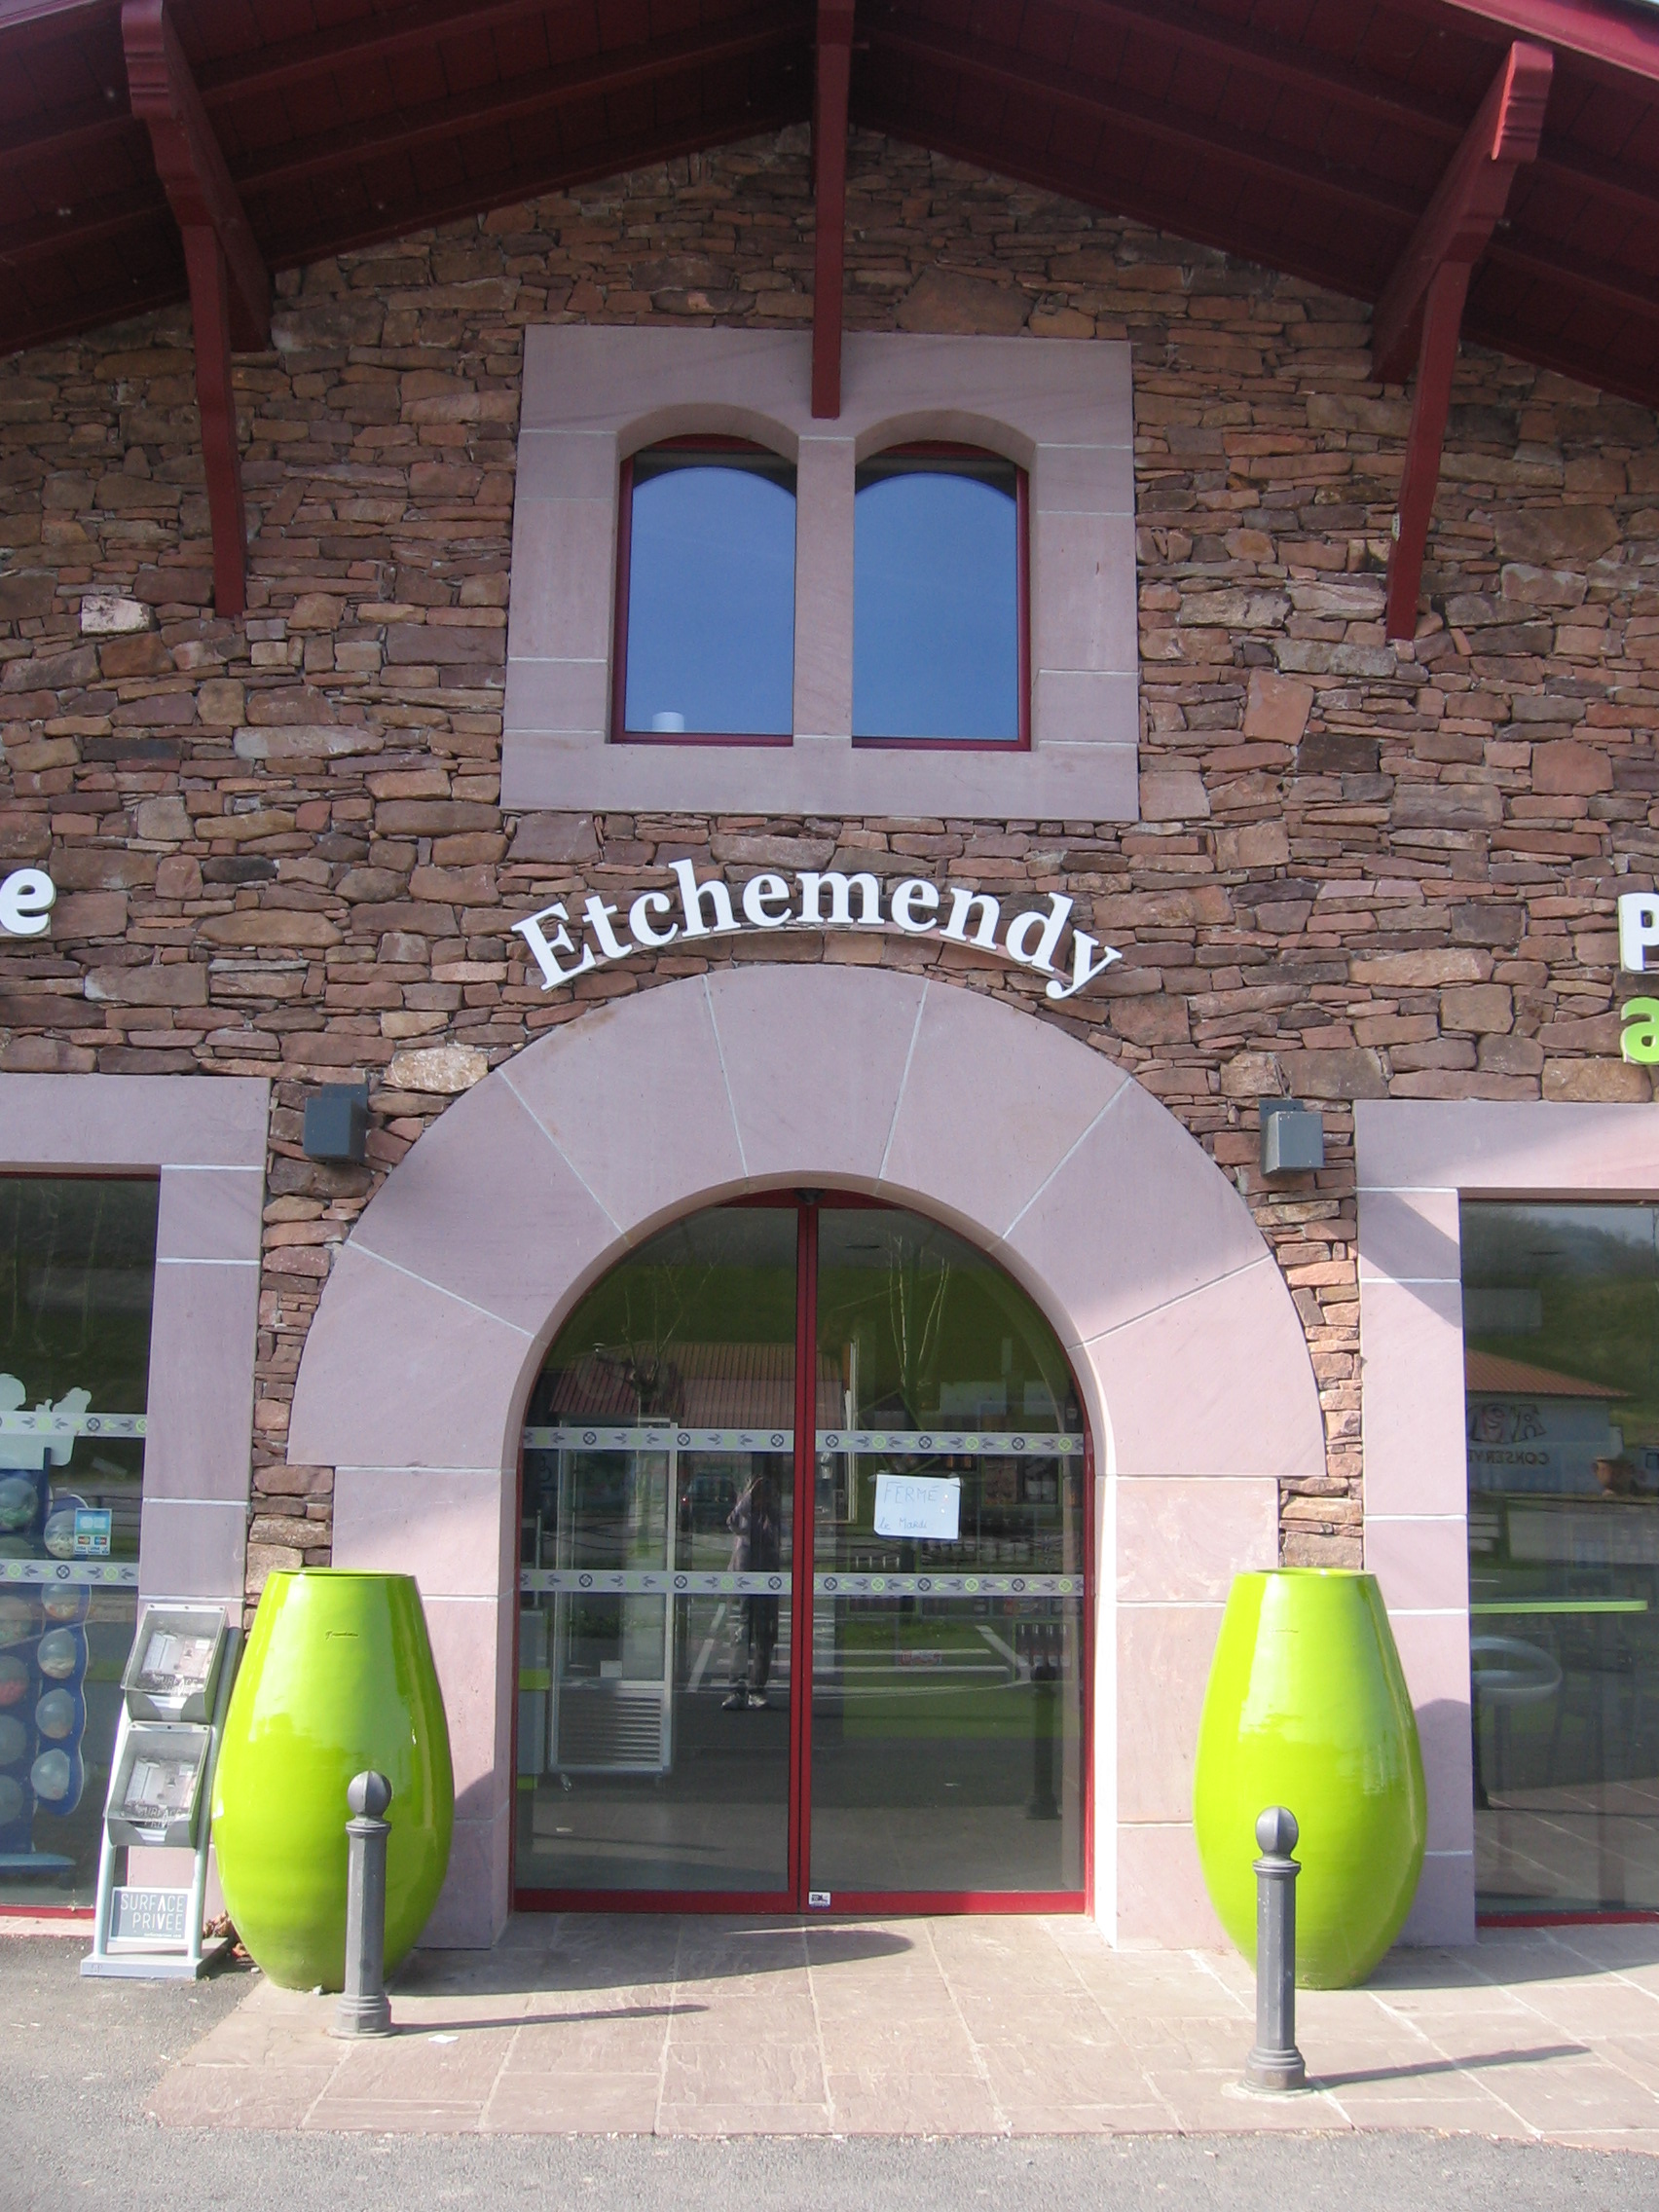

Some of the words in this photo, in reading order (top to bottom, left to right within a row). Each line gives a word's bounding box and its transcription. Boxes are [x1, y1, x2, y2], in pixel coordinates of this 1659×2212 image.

[511, 858, 1124, 1001] Etchemendy
[121, 1893, 185, 1913] SURFACE
[132, 1911, 183, 1932] PRIVEE
